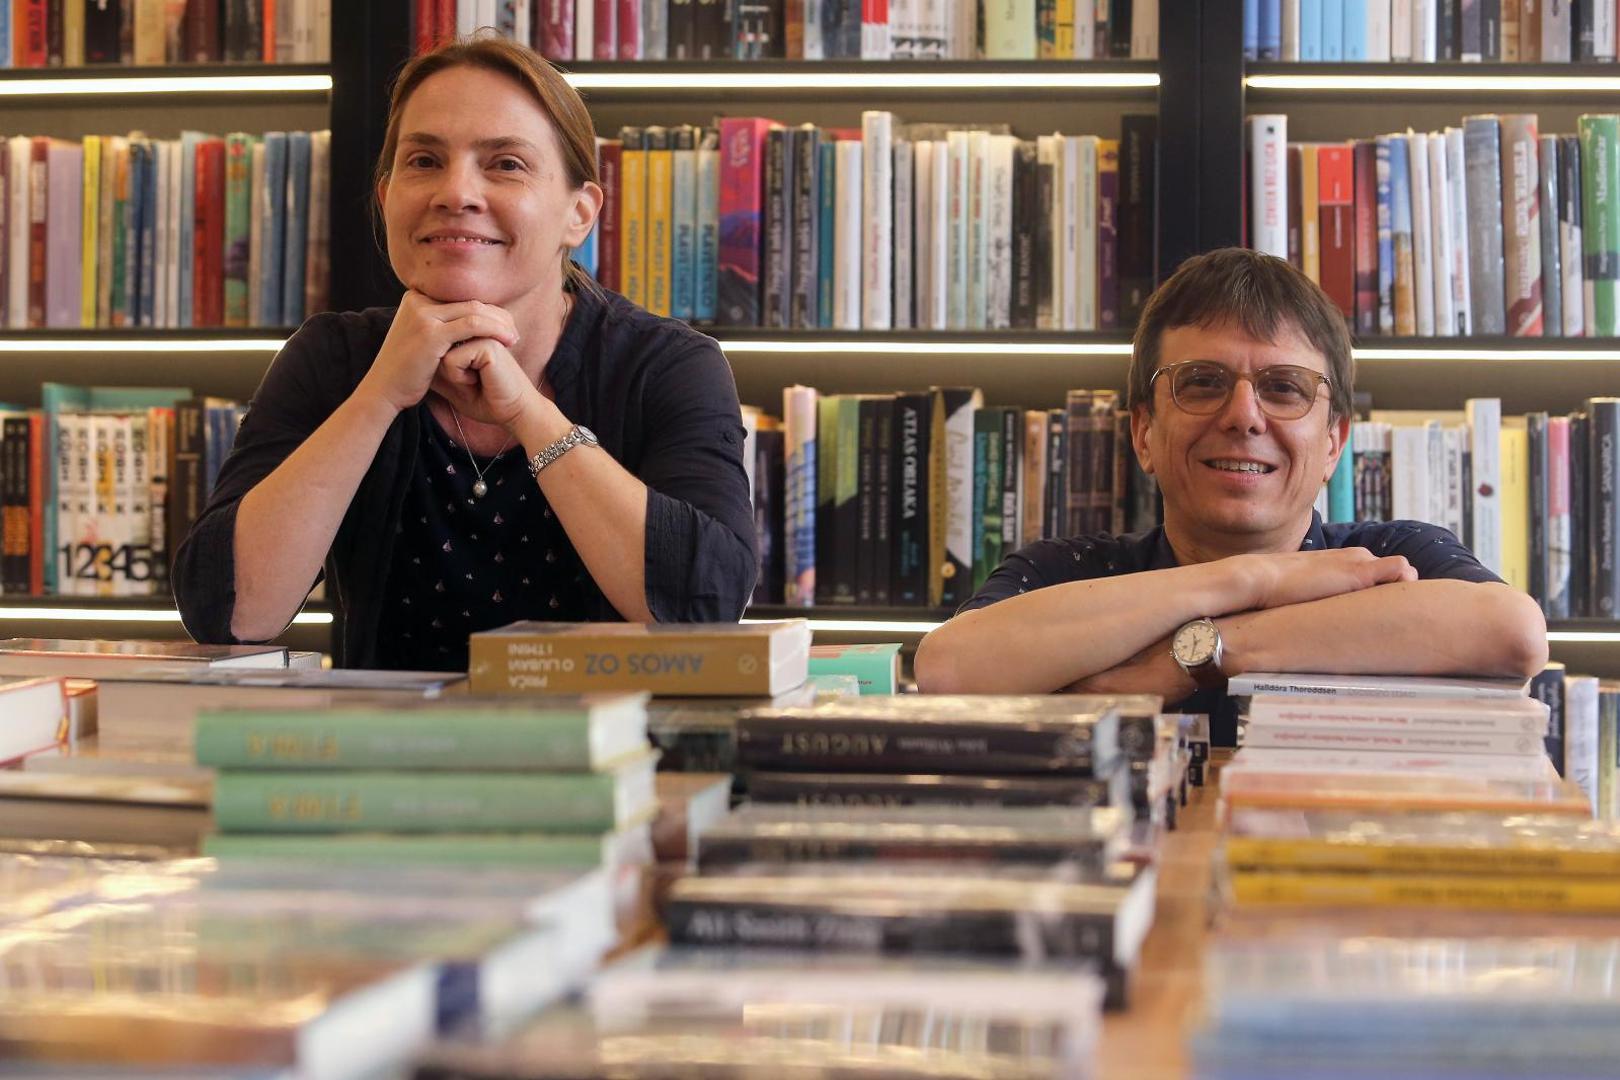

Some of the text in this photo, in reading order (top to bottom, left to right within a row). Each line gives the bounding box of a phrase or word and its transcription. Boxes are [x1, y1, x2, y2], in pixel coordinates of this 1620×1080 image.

[903, 408, 918, 454] ATLAS
[585, 653, 705, 675] AMOS OZ
[508, 674, 548, 688] PRIČA
[1289, 685, 1337, 697] Thoroddsen
[781, 733, 888, 755] AUGUST
